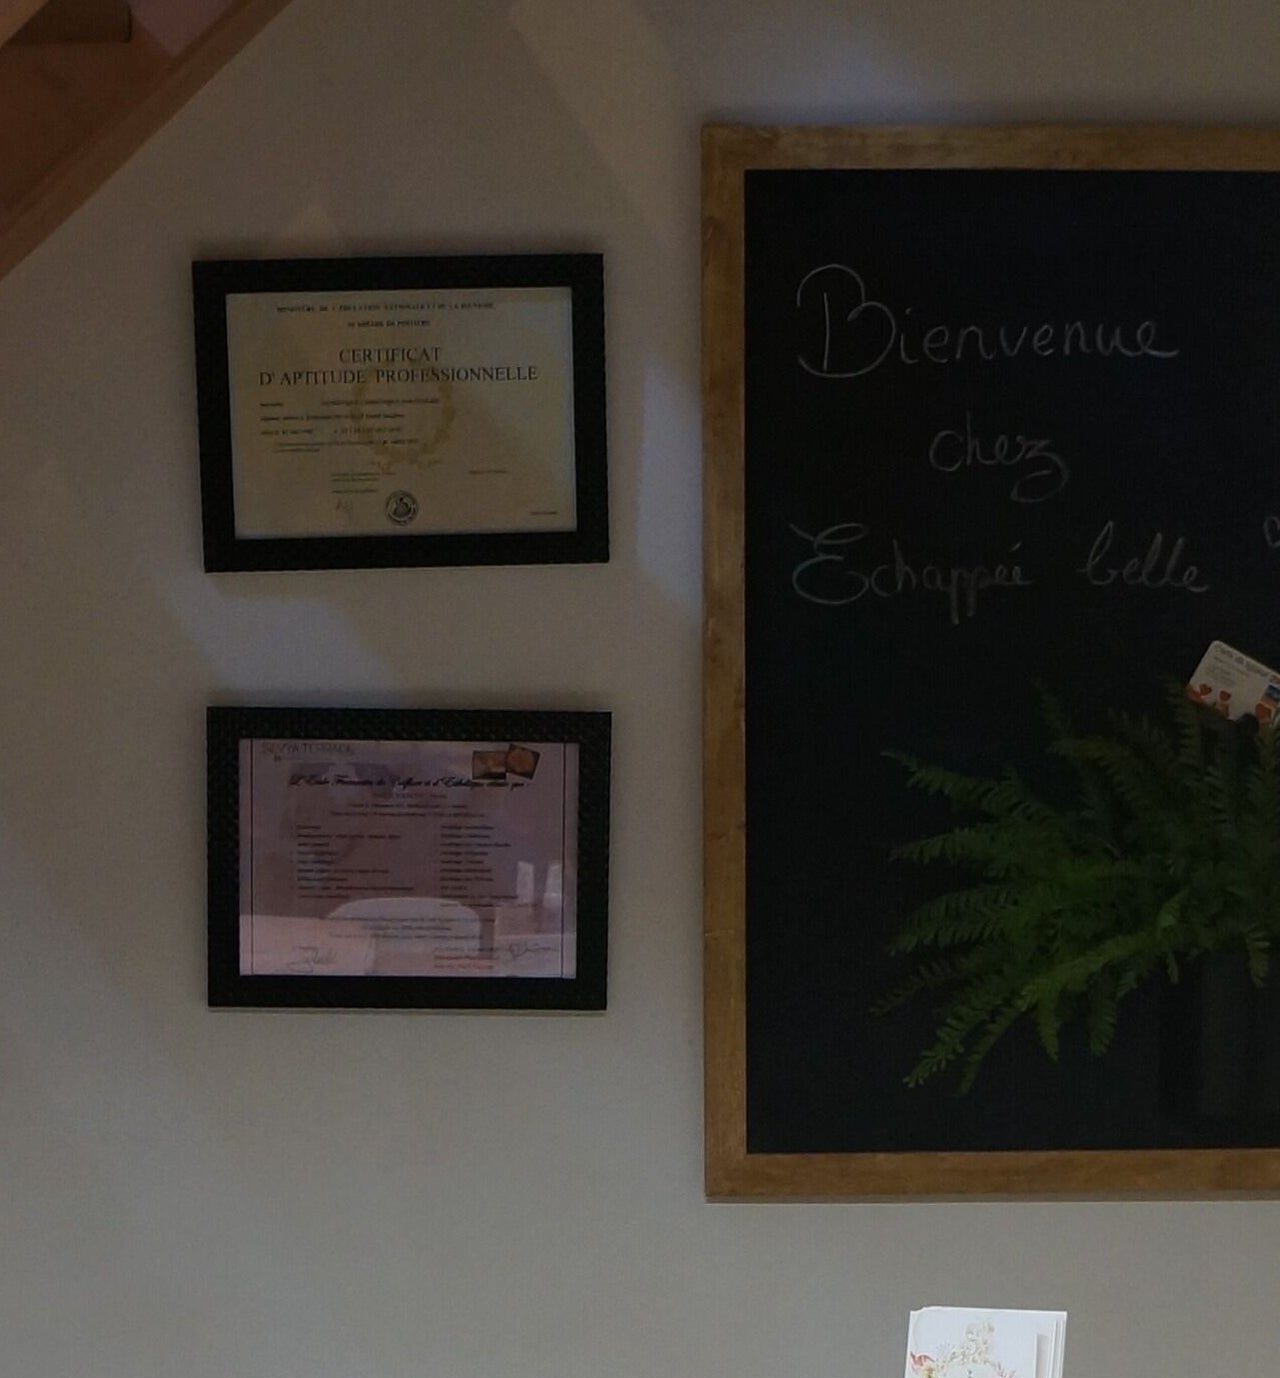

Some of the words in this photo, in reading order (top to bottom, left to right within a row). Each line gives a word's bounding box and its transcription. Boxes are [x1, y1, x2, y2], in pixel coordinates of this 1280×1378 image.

[338, 345, 441, 364] CERTIFICAT
[796, 264, 1180, 378] Bienvenue
[375, 365, 538, 383] PROFESSIONNELLE
[928, 410, 1070, 504] chez
[1076, 520, 1211, 593] belle
